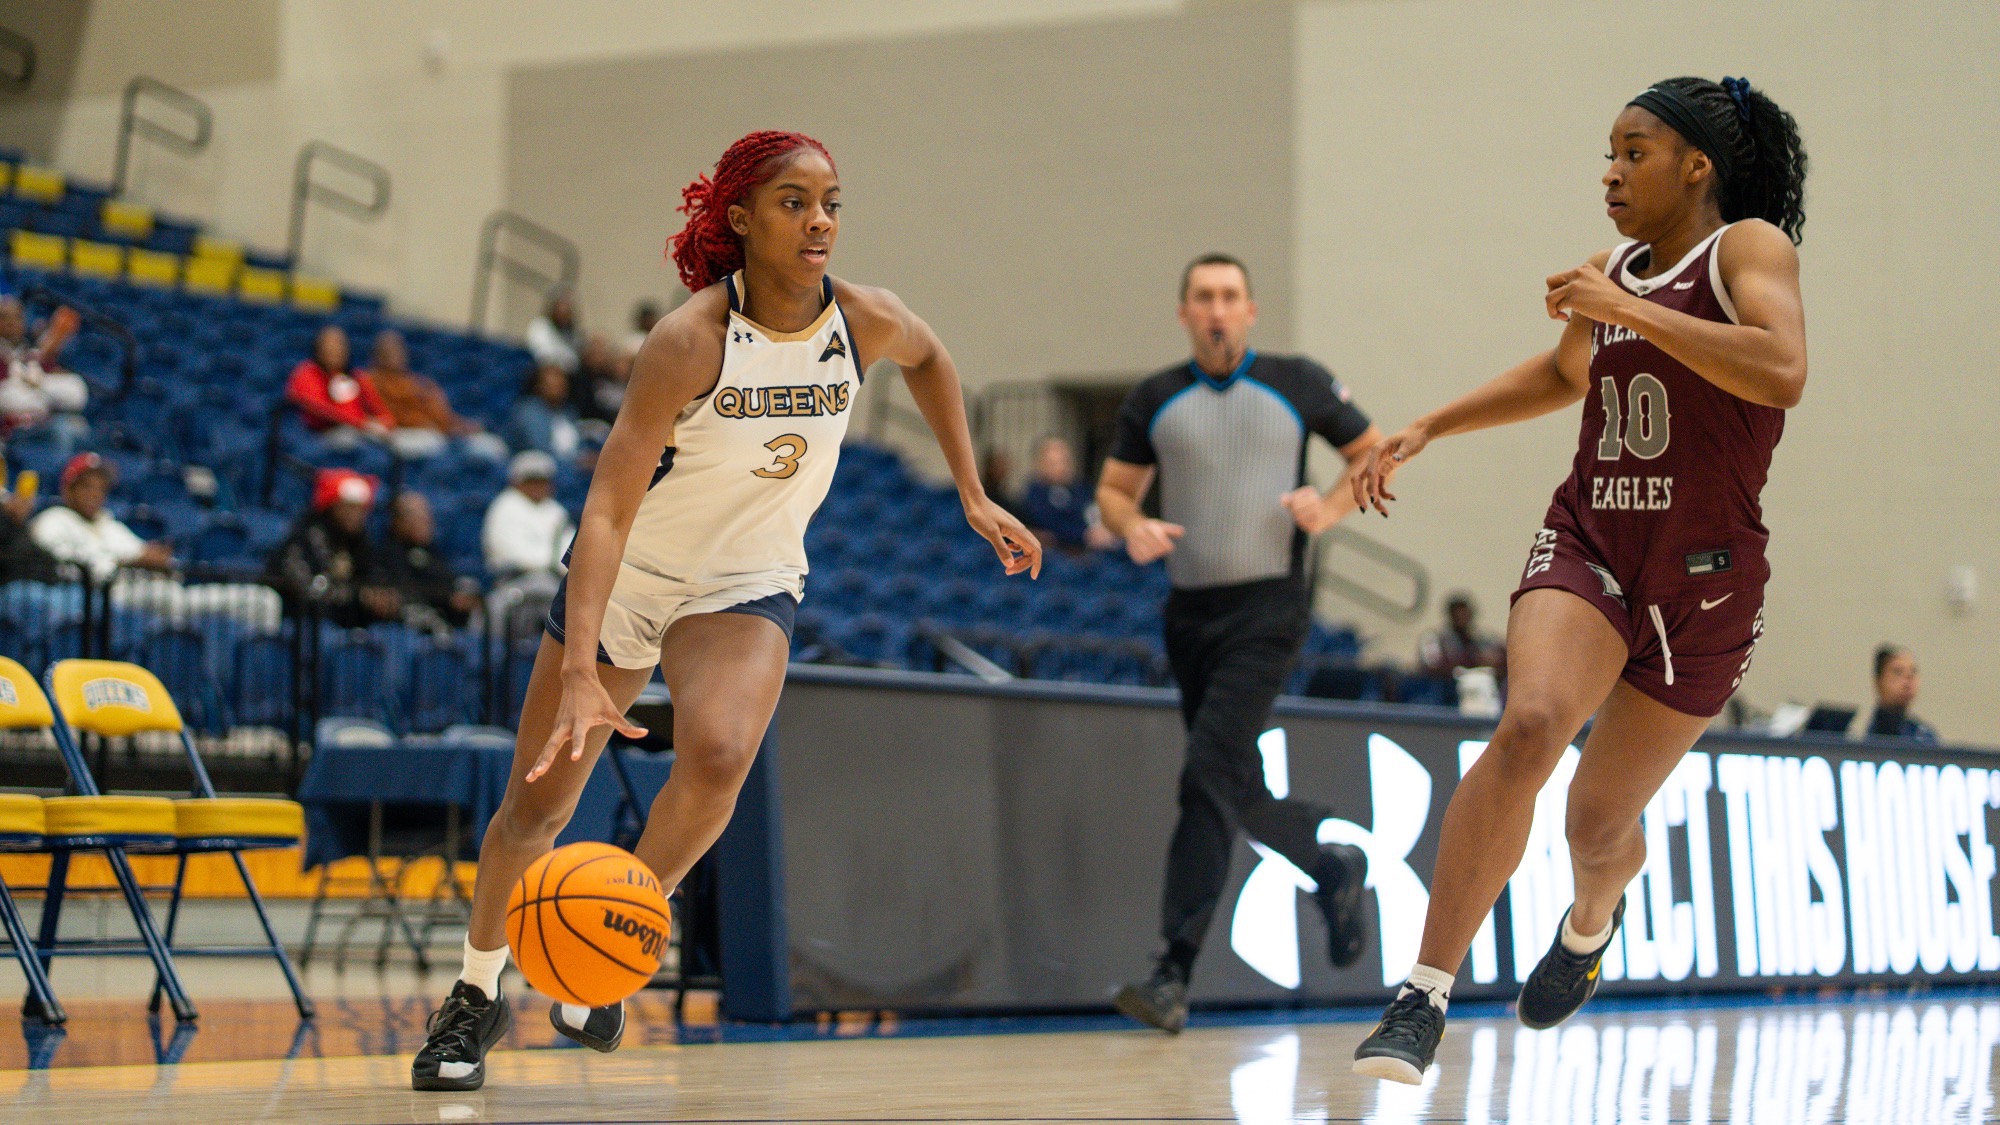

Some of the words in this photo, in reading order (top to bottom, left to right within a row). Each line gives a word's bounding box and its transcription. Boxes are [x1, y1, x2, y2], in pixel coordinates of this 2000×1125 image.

[713, 381, 850, 419] QUEENS
[1597, 372, 1672, 461] 10
[749, 432, 808, 480] 3
[1591, 475, 1674, 511] EAGLES
[1717, 556, 1726, 566] S
[1717, 752, 1847, 978] THIS
[1840, 758, 2000, 976] HOUSE
